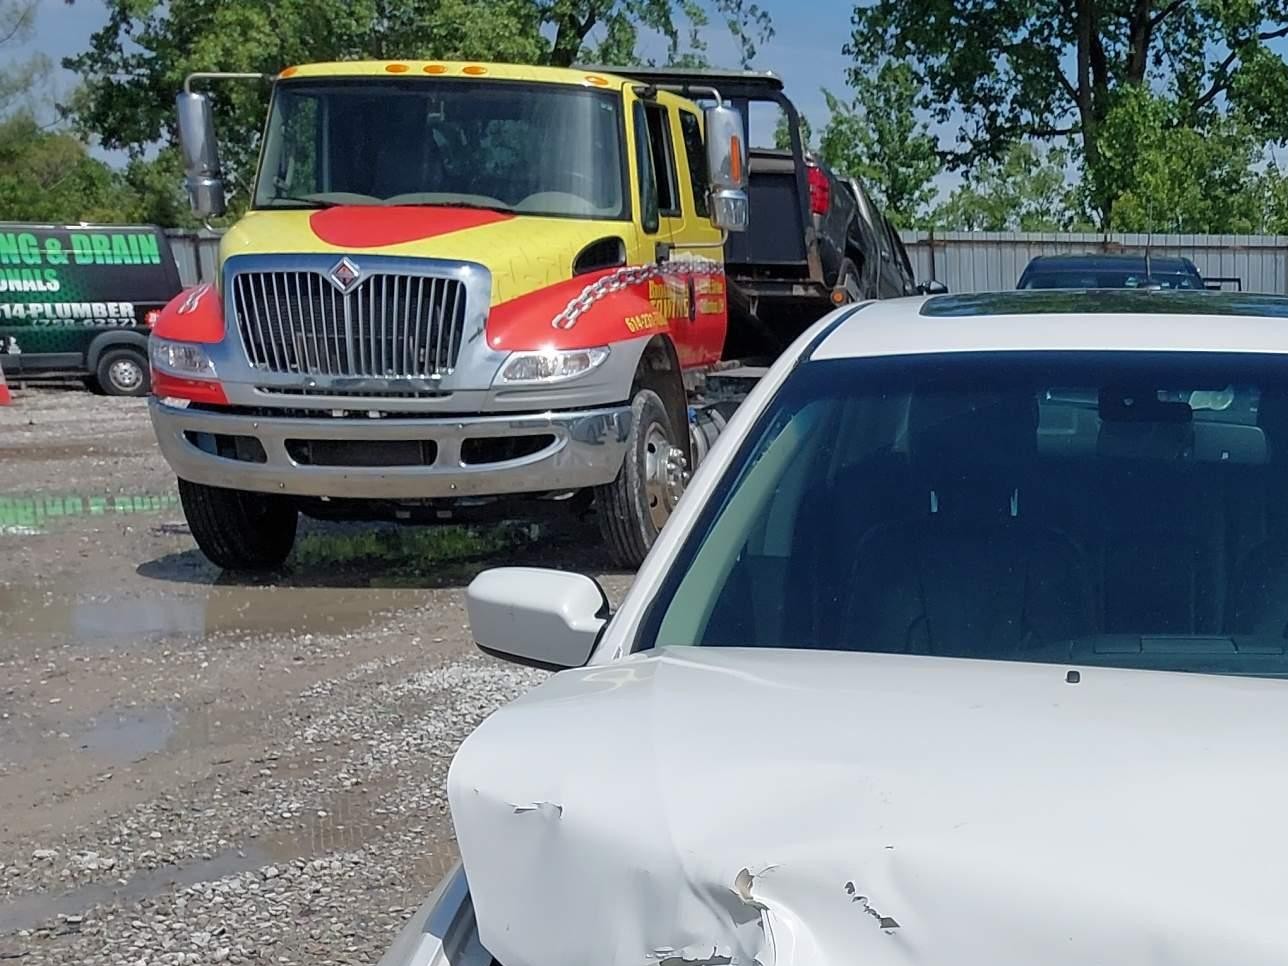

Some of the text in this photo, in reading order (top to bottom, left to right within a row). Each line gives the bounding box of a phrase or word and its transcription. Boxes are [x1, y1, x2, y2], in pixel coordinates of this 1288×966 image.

[45, 238, 69, 264] &
[71, 234, 160, 264] DRAIN
[0, 302, 135, 319] 14-PLUMBER
